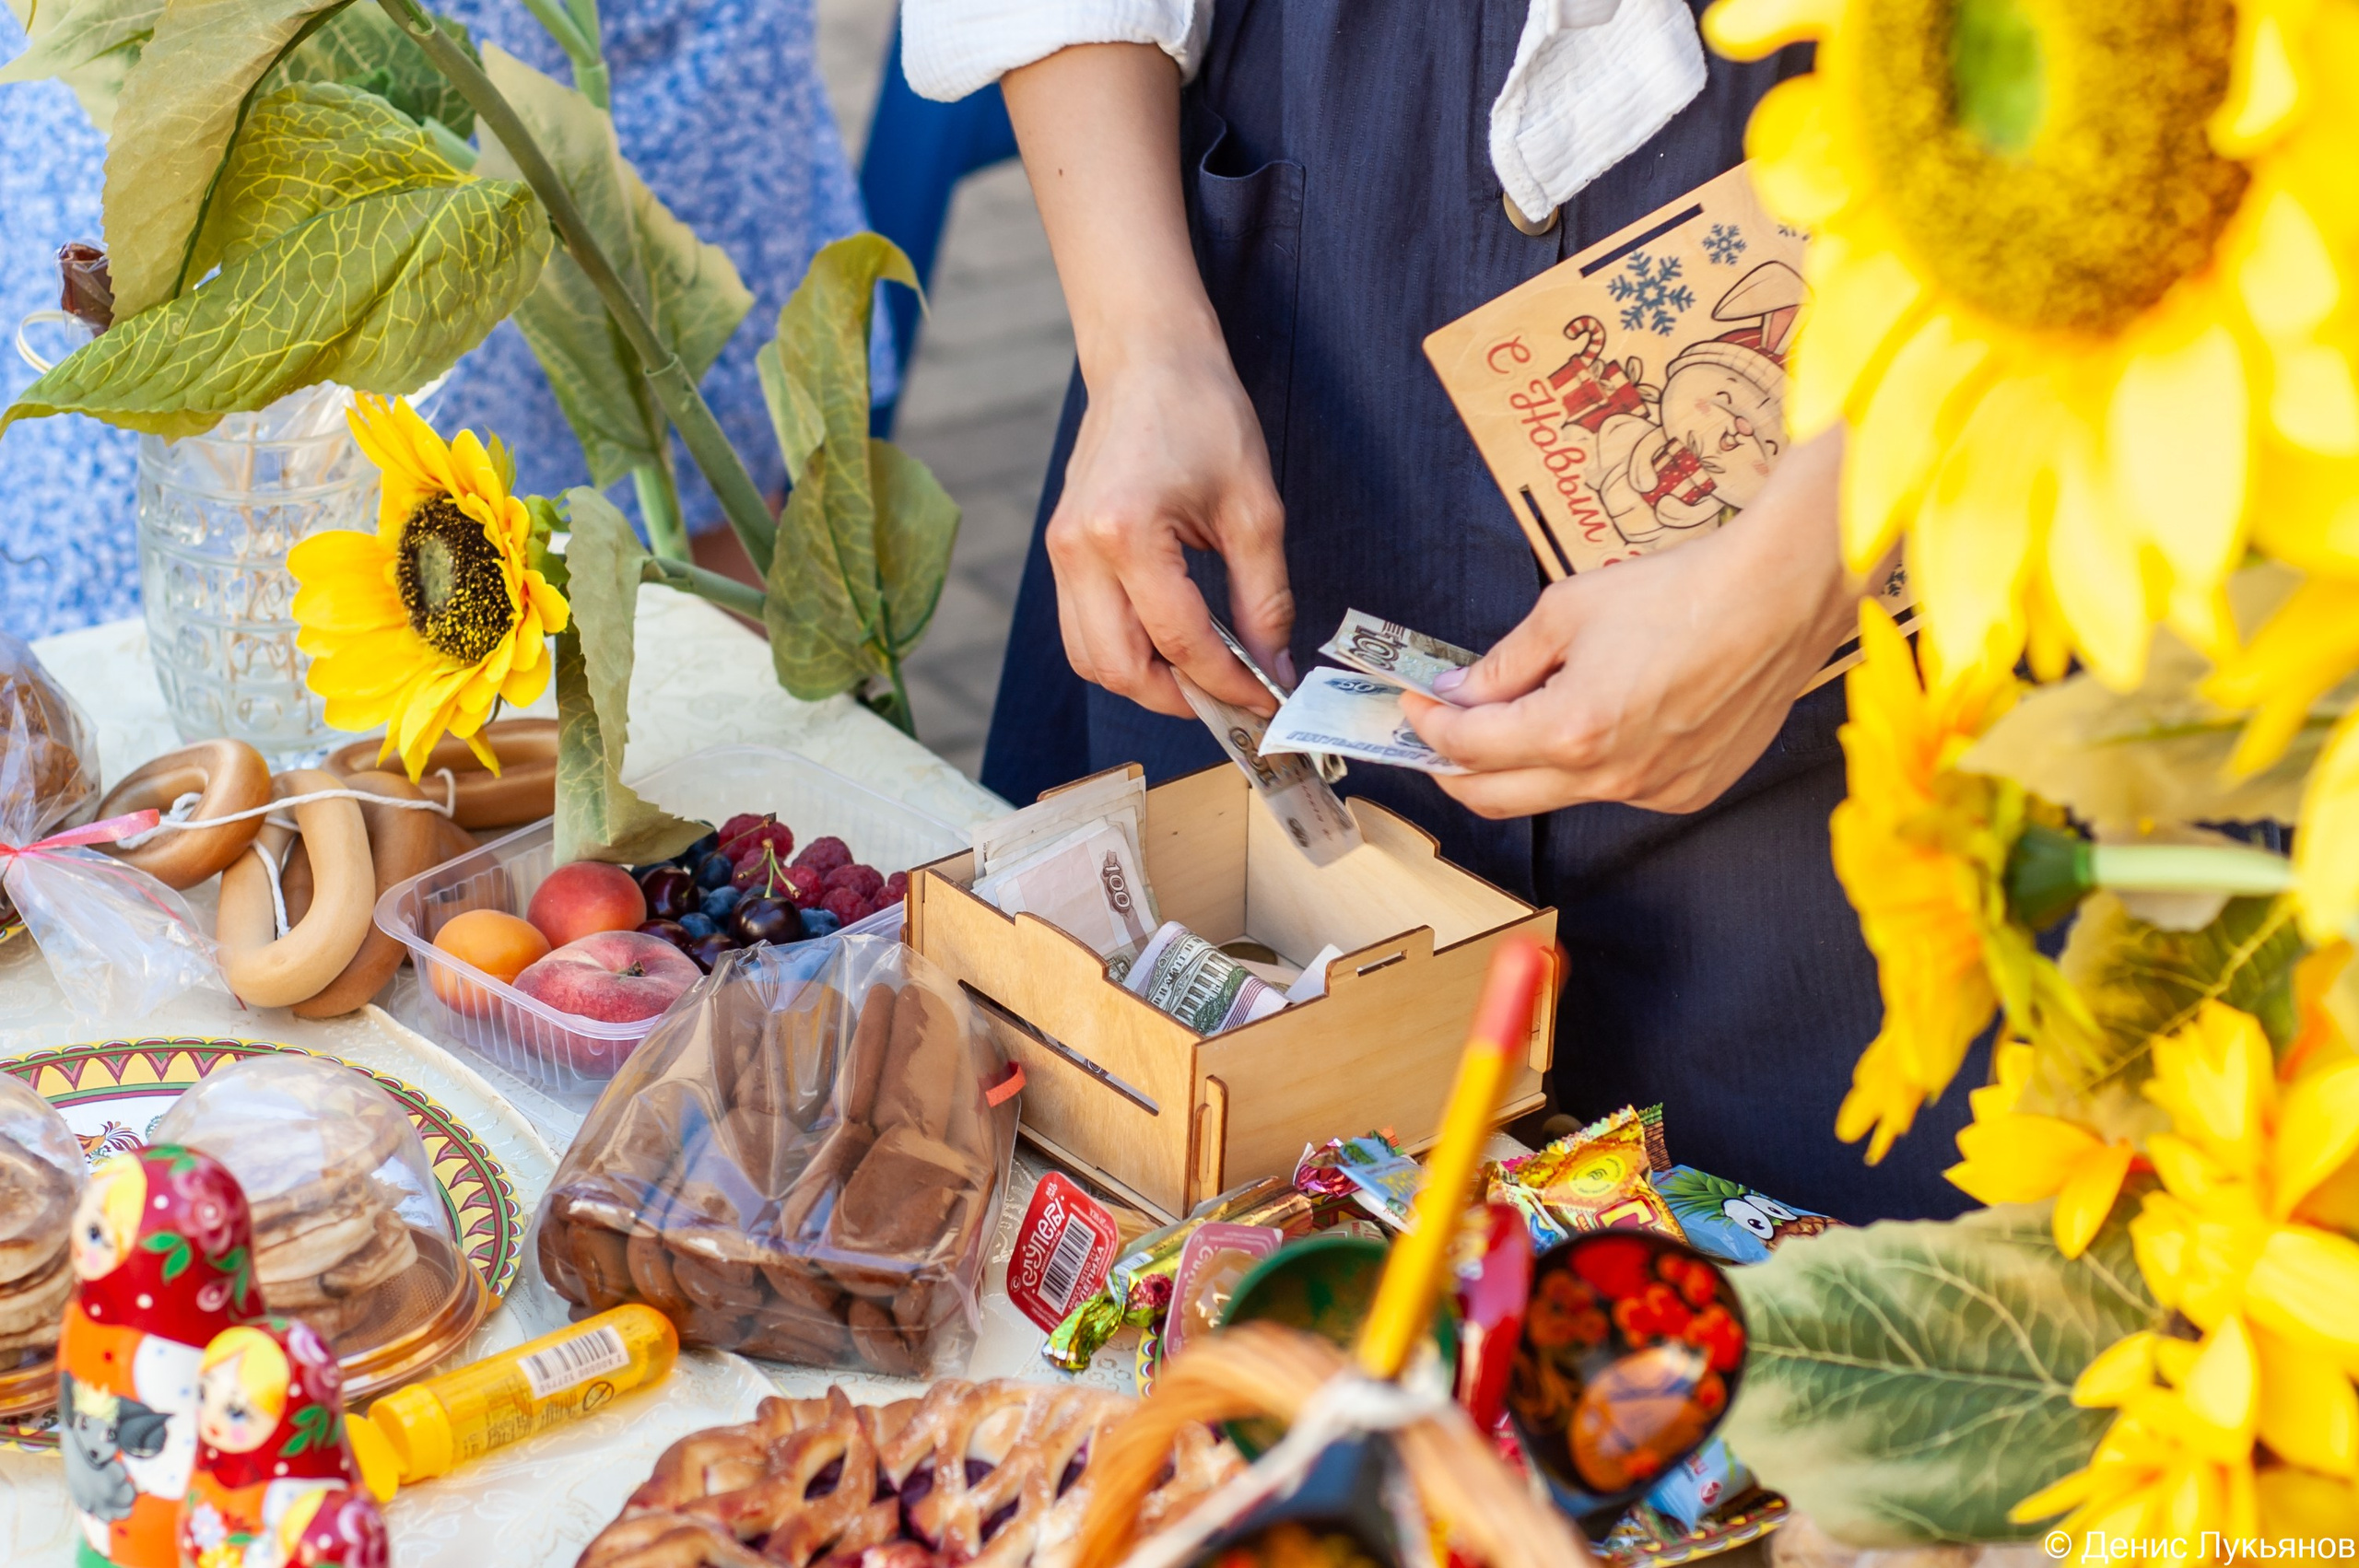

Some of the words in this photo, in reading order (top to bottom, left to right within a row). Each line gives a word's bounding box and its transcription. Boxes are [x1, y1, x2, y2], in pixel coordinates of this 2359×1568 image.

[1486, 335, 1531, 374] С
[1509, 379, 1607, 544] Новым
[1338, 679, 1377, 694] 50
[1103, 863, 1132, 913] 100
